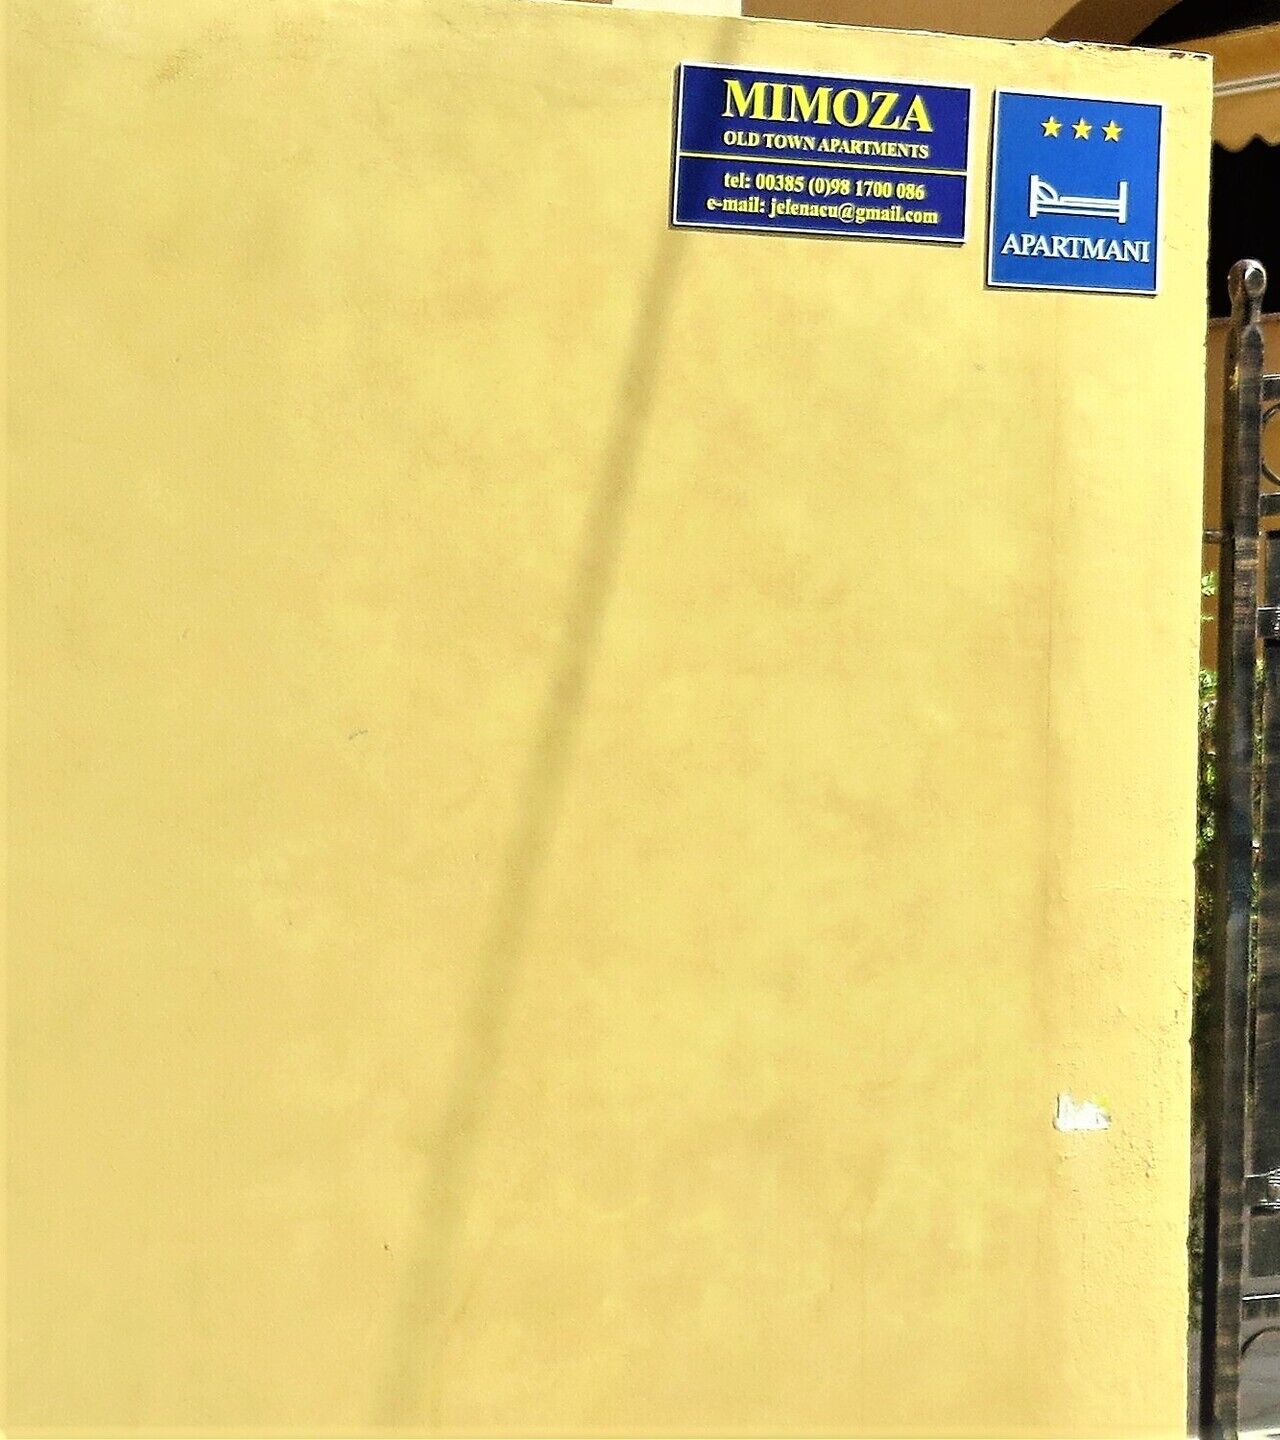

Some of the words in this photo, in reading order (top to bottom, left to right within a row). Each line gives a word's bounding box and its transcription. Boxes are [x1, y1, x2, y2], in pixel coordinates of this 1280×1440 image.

[721, 78, 933, 133] MIMOZA
[723, 130, 760, 146] OLD
[763, 133, 816, 151] TOWN
[817, 137, 930, 159] APARTMENTS
[723, 172, 751, 189] tel:
[755, 173, 804, 192] 00385
[808, 177, 850, 197] (0)98
[855, 180, 893, 199] 1700
[896, 183, 926, 200] 086
[706, 196, 766, 213] e-mail:
[767, 199, 939, 224] jelenacu@gmail.com
[1001, 232, 1151, 264] APARTMANI
